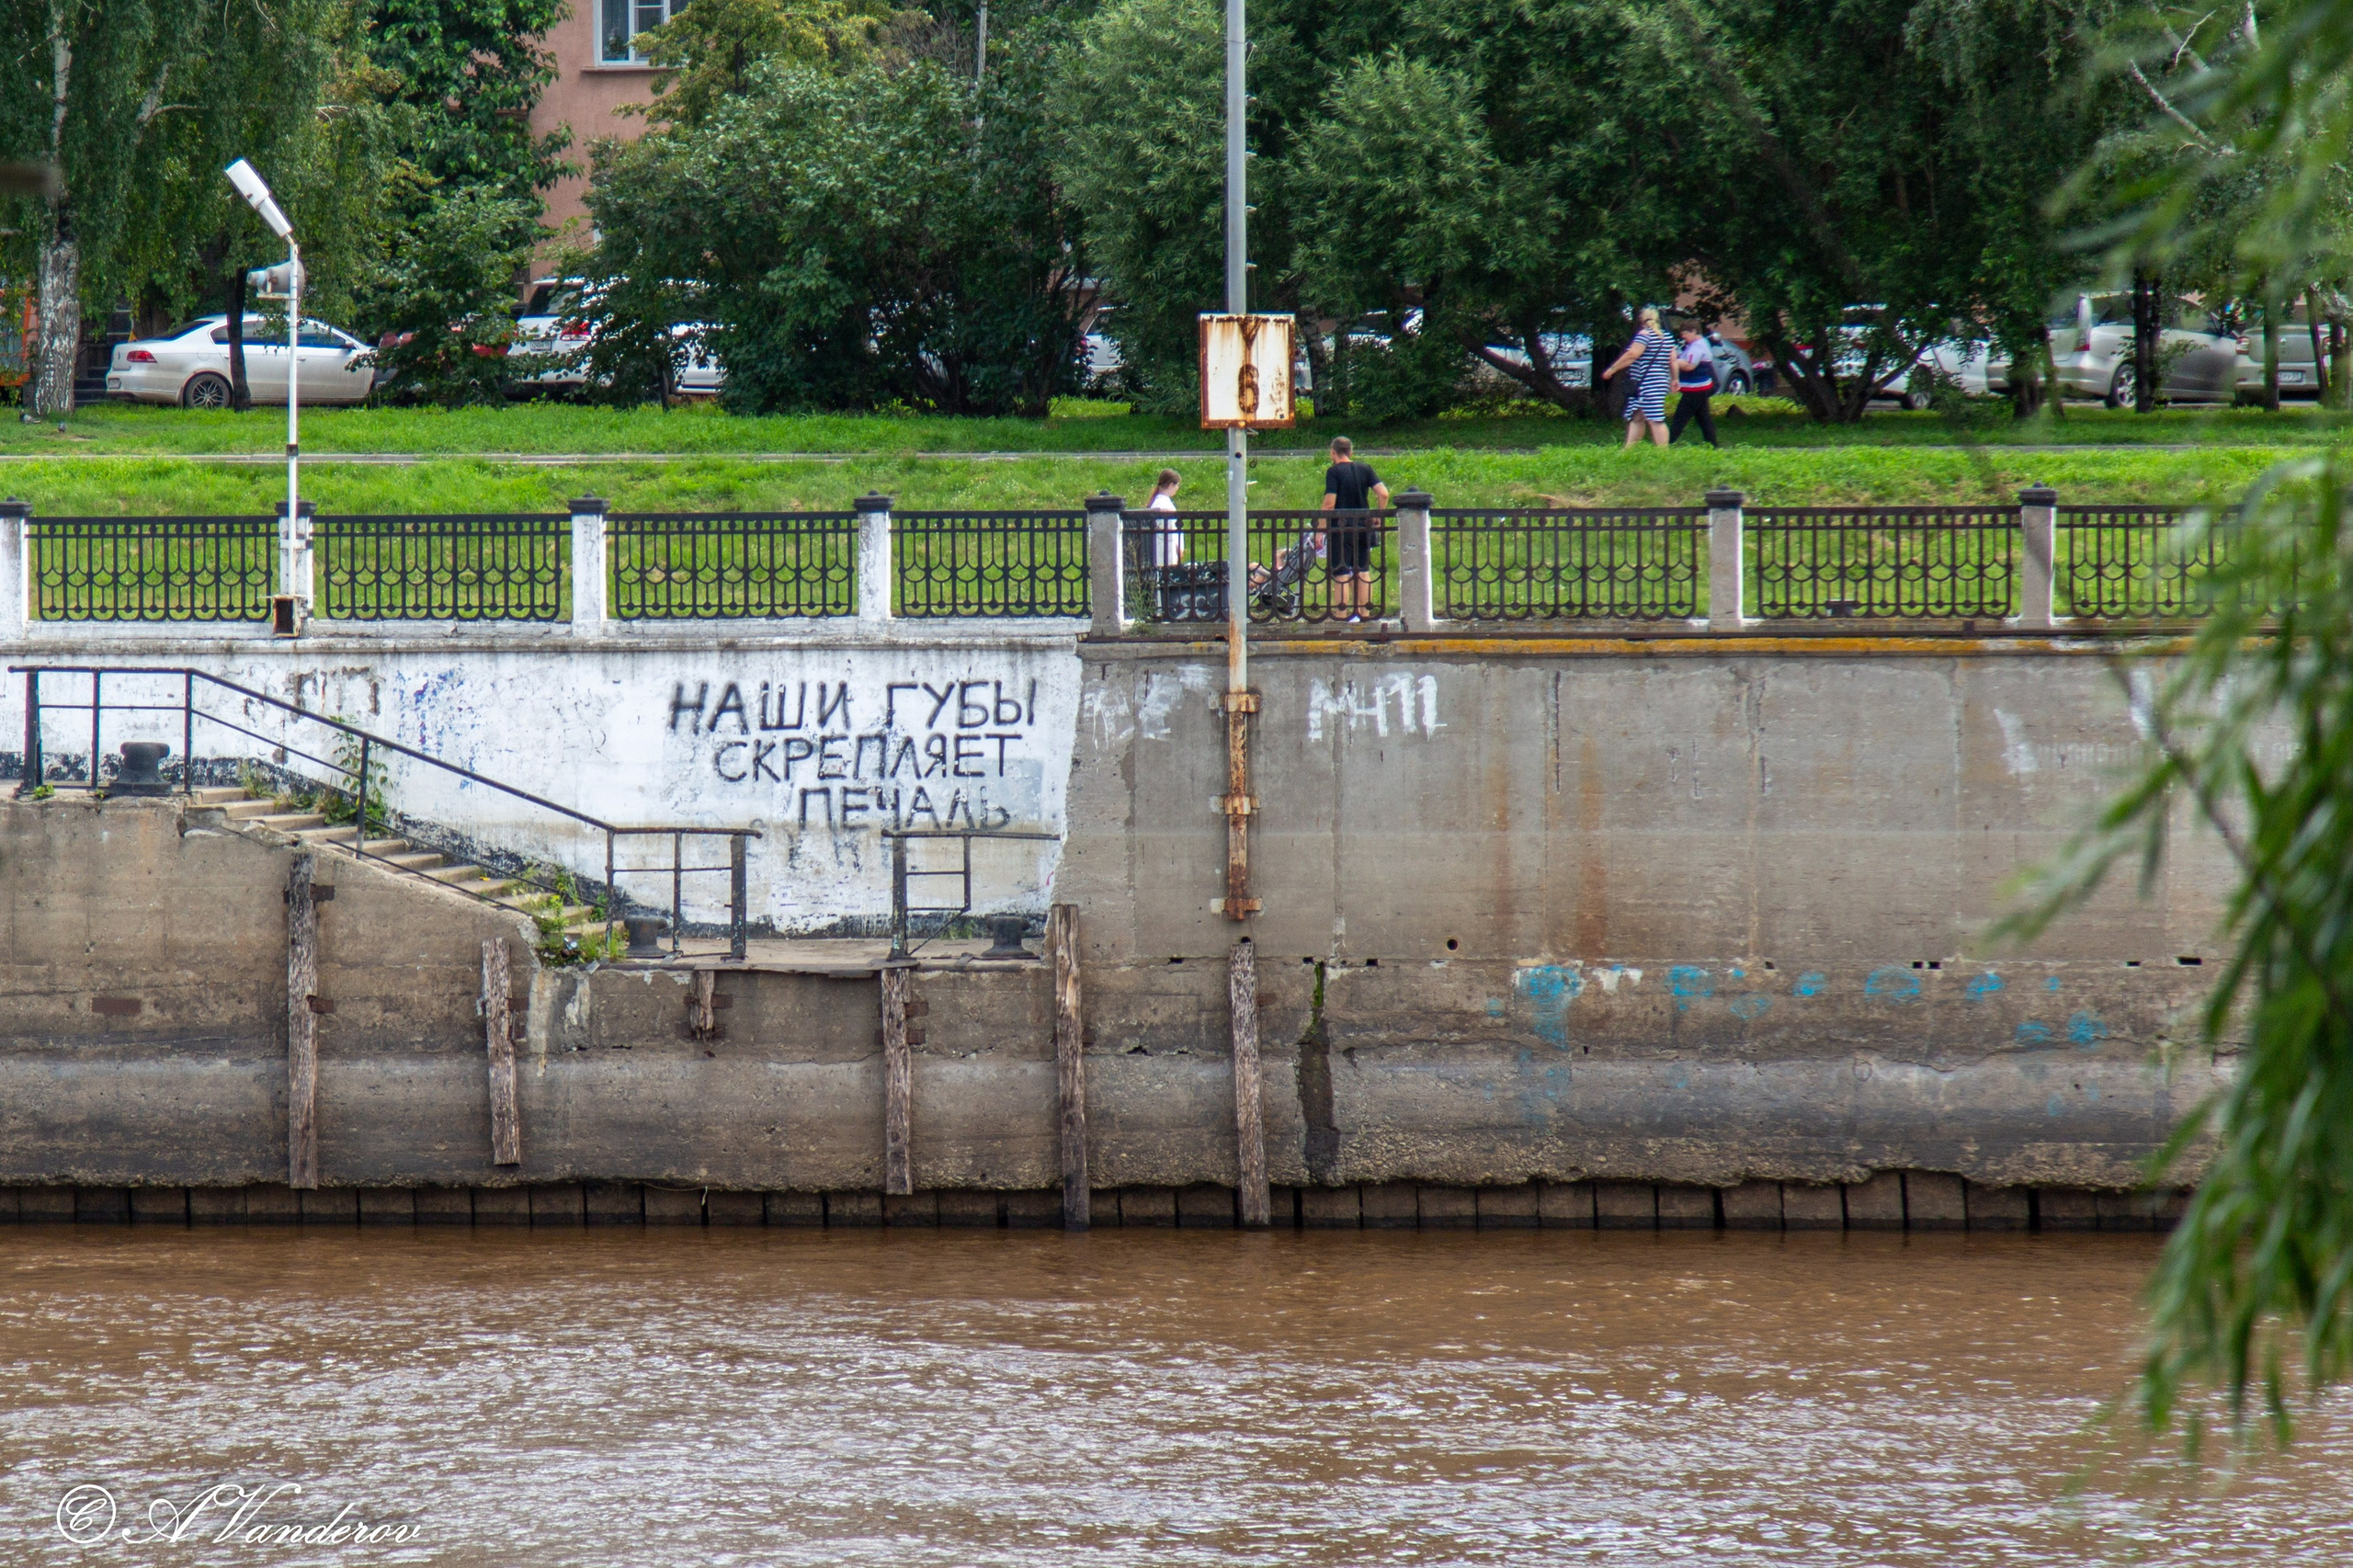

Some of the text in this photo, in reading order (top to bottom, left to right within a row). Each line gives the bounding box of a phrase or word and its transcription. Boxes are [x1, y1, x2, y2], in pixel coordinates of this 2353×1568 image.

[667, 679, 851, 734] НАШИ
[886, 677, 1037, 729] ГУБЫ
[712, 733, 1022, 783] СКРЕПЛЯЕТ
[798, 785, 1011, 830] ПЕЧАЛЬ
